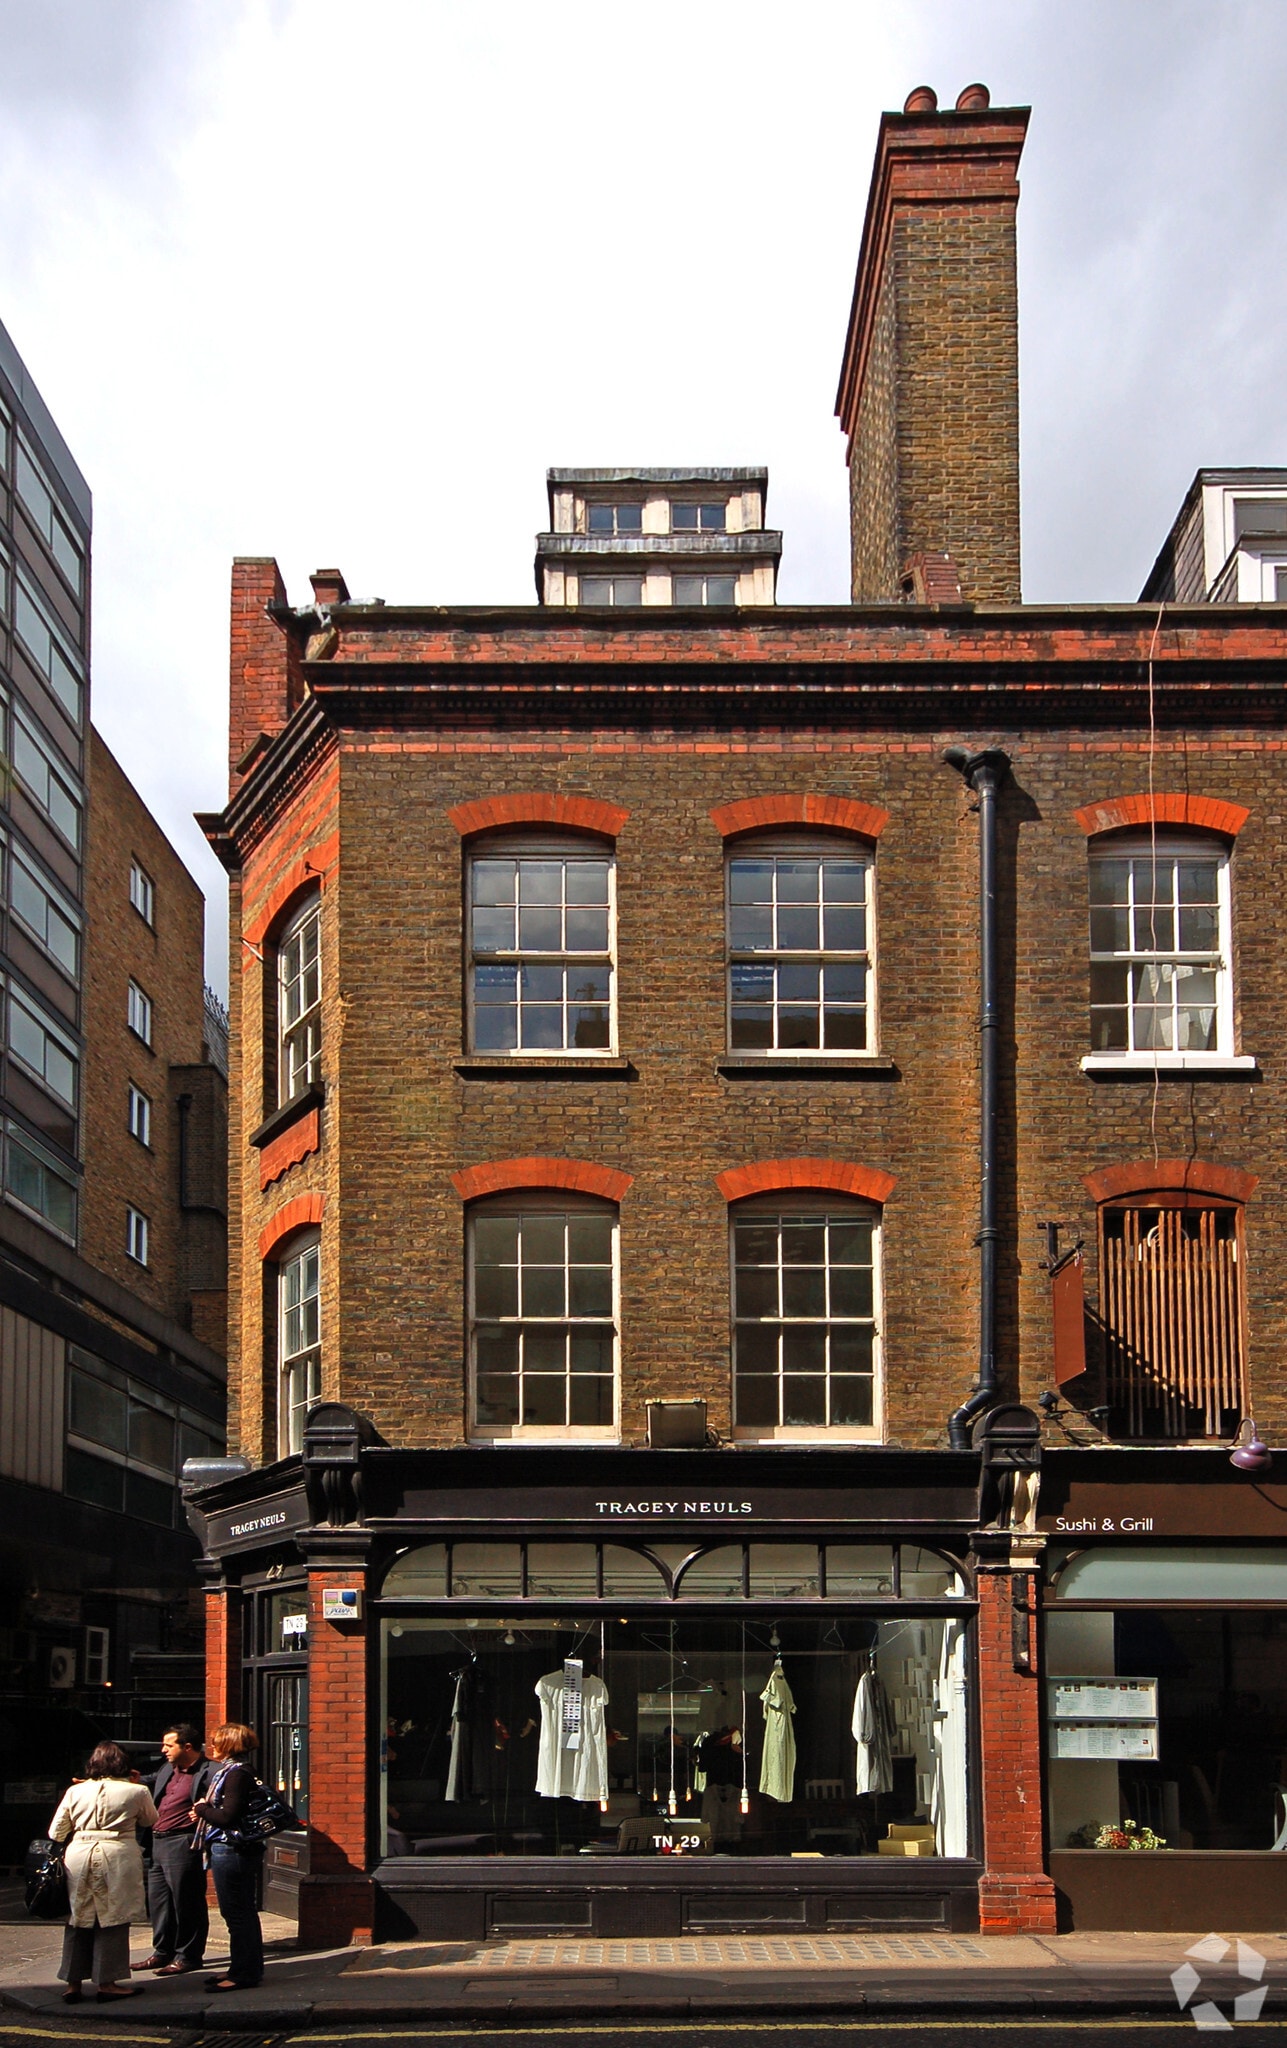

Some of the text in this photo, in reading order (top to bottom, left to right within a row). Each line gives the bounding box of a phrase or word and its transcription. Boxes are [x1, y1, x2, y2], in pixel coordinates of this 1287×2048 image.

[683, 1502, 753, 1513] NEULS
[260, 1512, 286, 1528] NEULS
[1055, 1517, 1153, 1531] Sushi & Grill
[652, 1835, 700, 1853] TN_29
